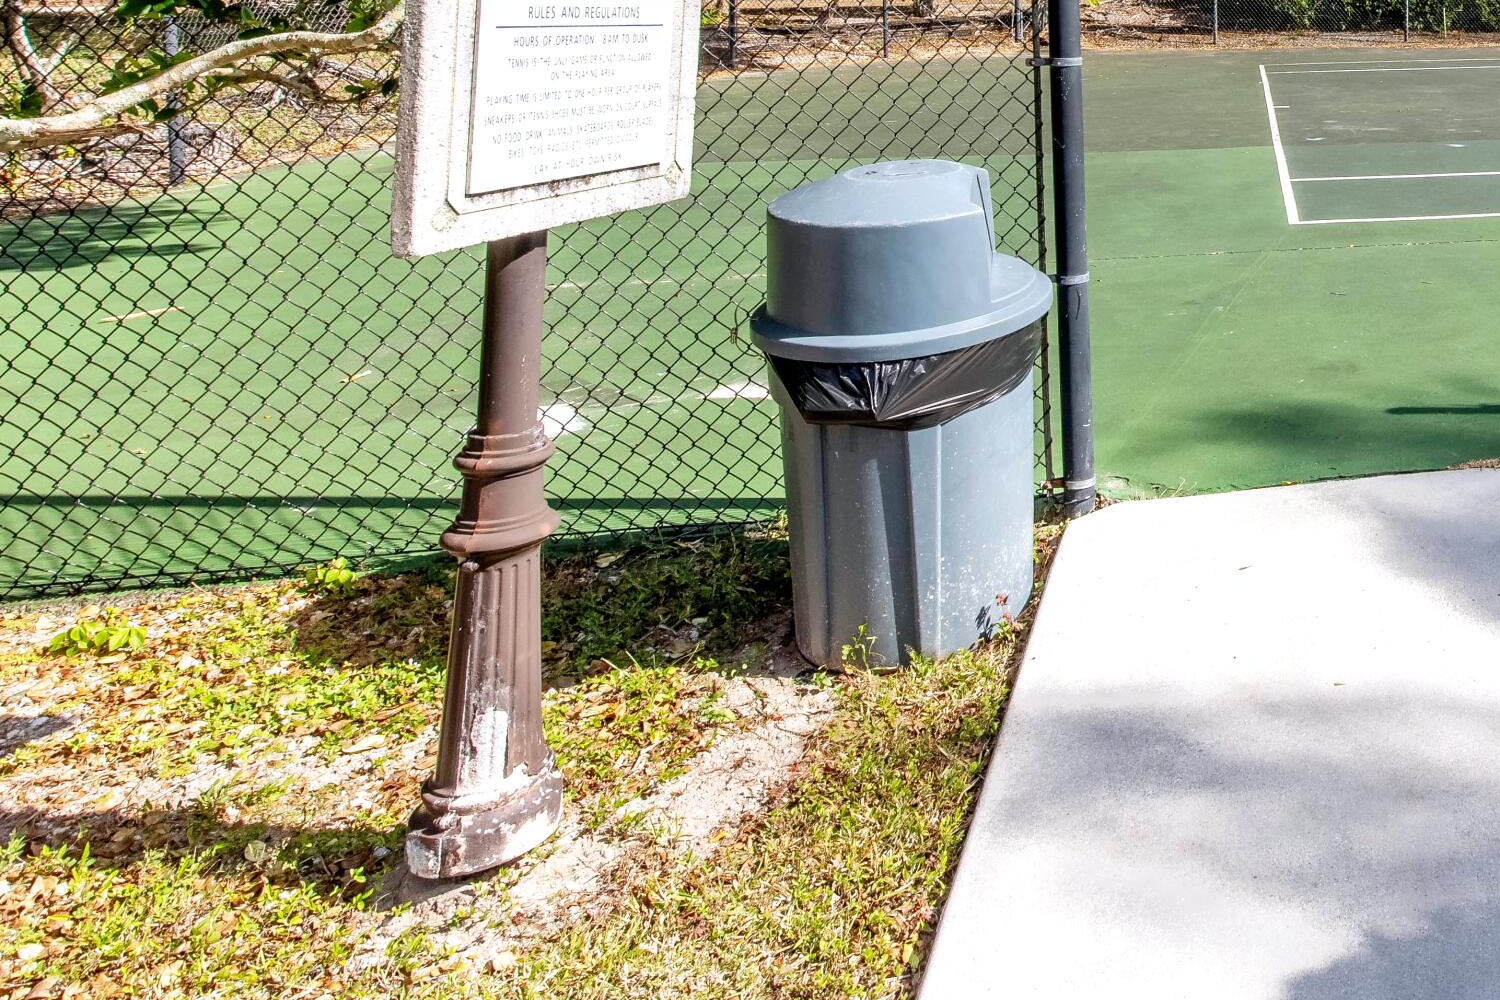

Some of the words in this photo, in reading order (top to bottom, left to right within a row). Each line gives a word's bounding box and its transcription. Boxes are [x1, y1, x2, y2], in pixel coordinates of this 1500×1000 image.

[528, 6, 556, 19] RULES
[561, 6, 581, 19] AND
[584, 6, 641, 19] REGULATIONS
[513, 35, 540, 48] HOURS
[543, 35, 553, 46] OF
[621, 33, 631, 44] TO
[632, 33, 649, 43] DUSK
[508, 57, 530, 68] TENNIS
[550, 71, 561, 81] ON
[486, 95, 514, 106] PLAYING
[516, 93, 531, 103] TIME
[492, 134, 502, 145] NO
[504, 132, 522, 144] FOOD
